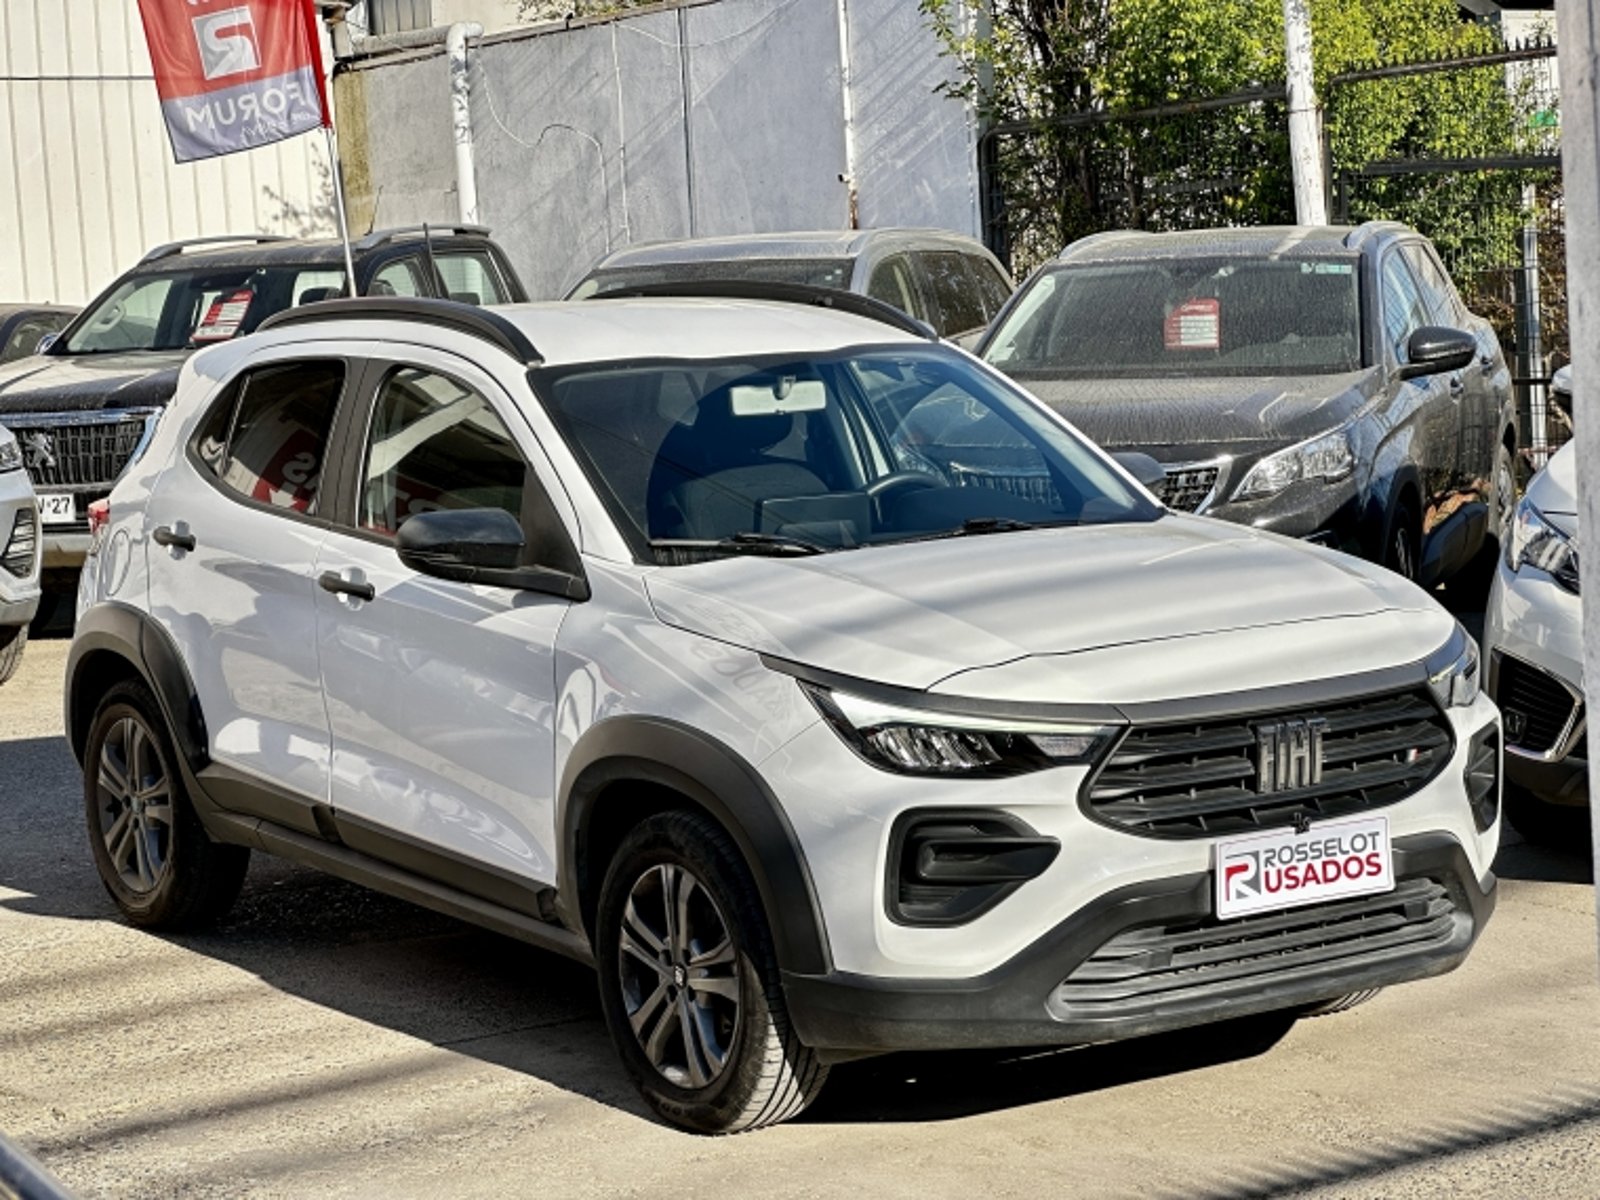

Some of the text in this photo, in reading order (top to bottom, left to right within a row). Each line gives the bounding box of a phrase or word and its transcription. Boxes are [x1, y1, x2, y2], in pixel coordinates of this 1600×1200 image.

[1257, 718, 1330, 794] FIAT
[1264, 831, 1380, 867] ROSSELOT
[1264, 853, 1382, 894] USADOS
